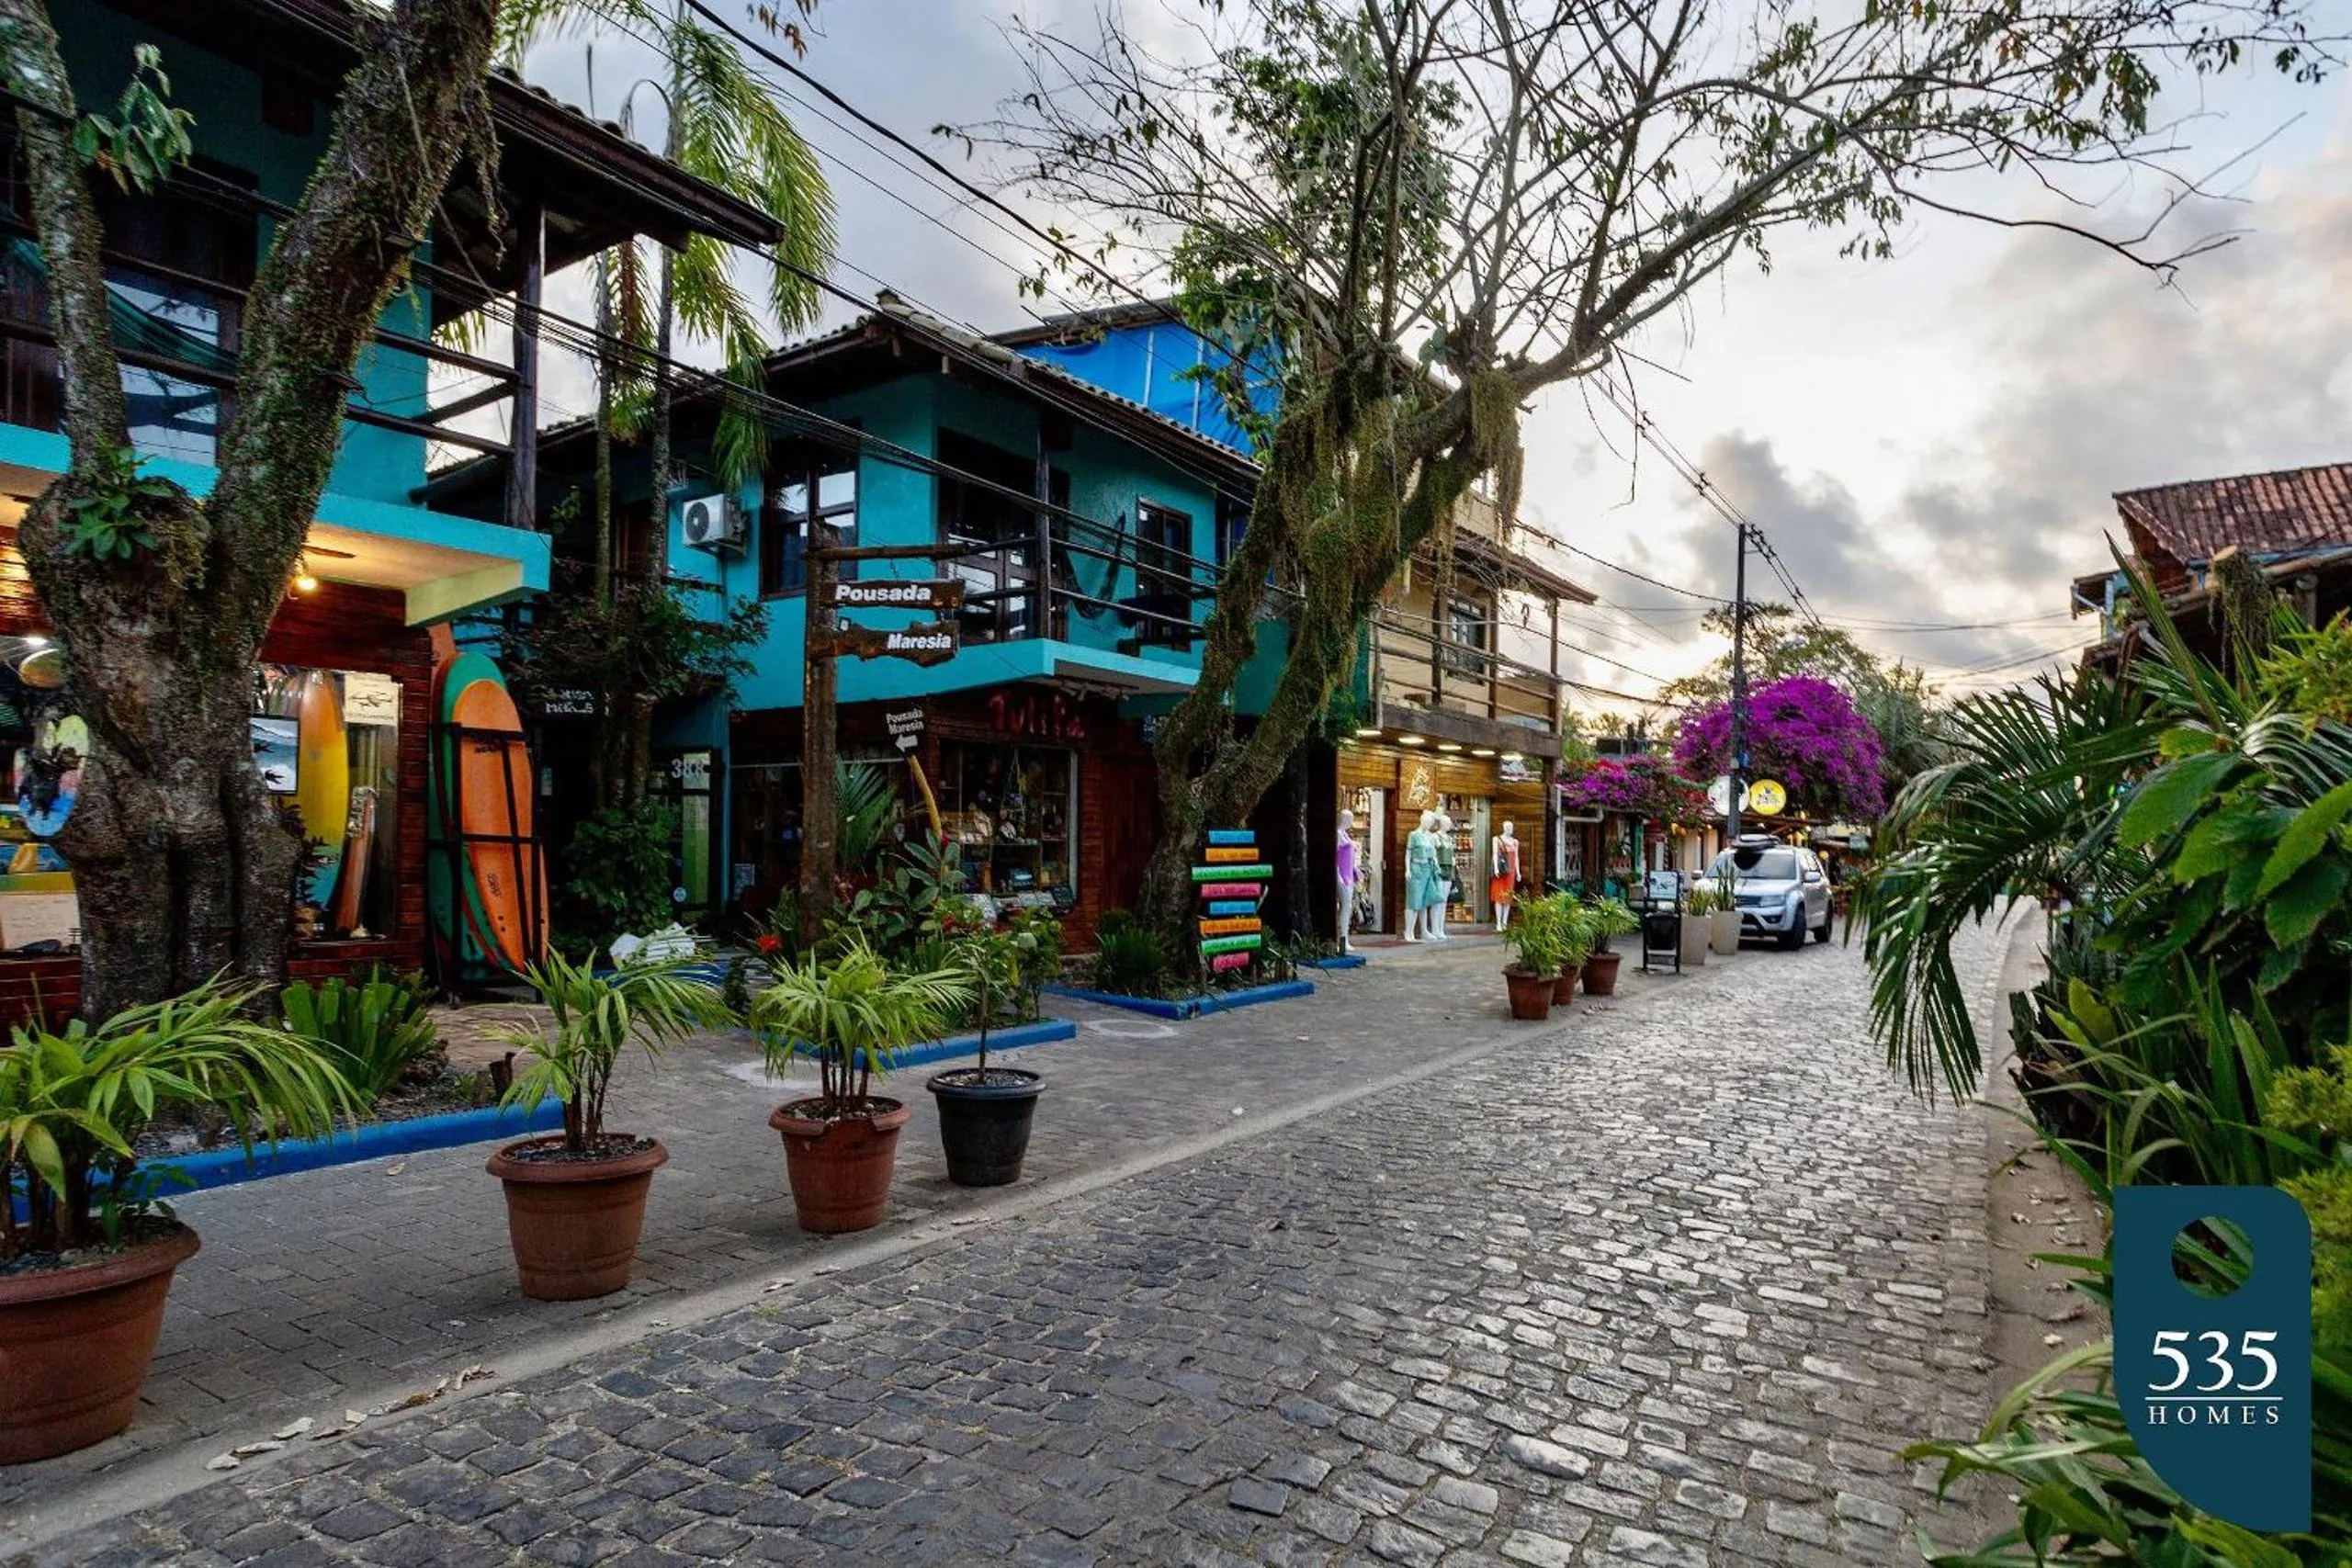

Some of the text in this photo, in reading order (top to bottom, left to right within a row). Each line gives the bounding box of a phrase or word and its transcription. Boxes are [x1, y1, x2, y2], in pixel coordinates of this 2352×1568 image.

[834, 584, 932, 602] Pousada
[887, 633, 952, 649] Maresia
[885, 708, 924, 724] Pousada
